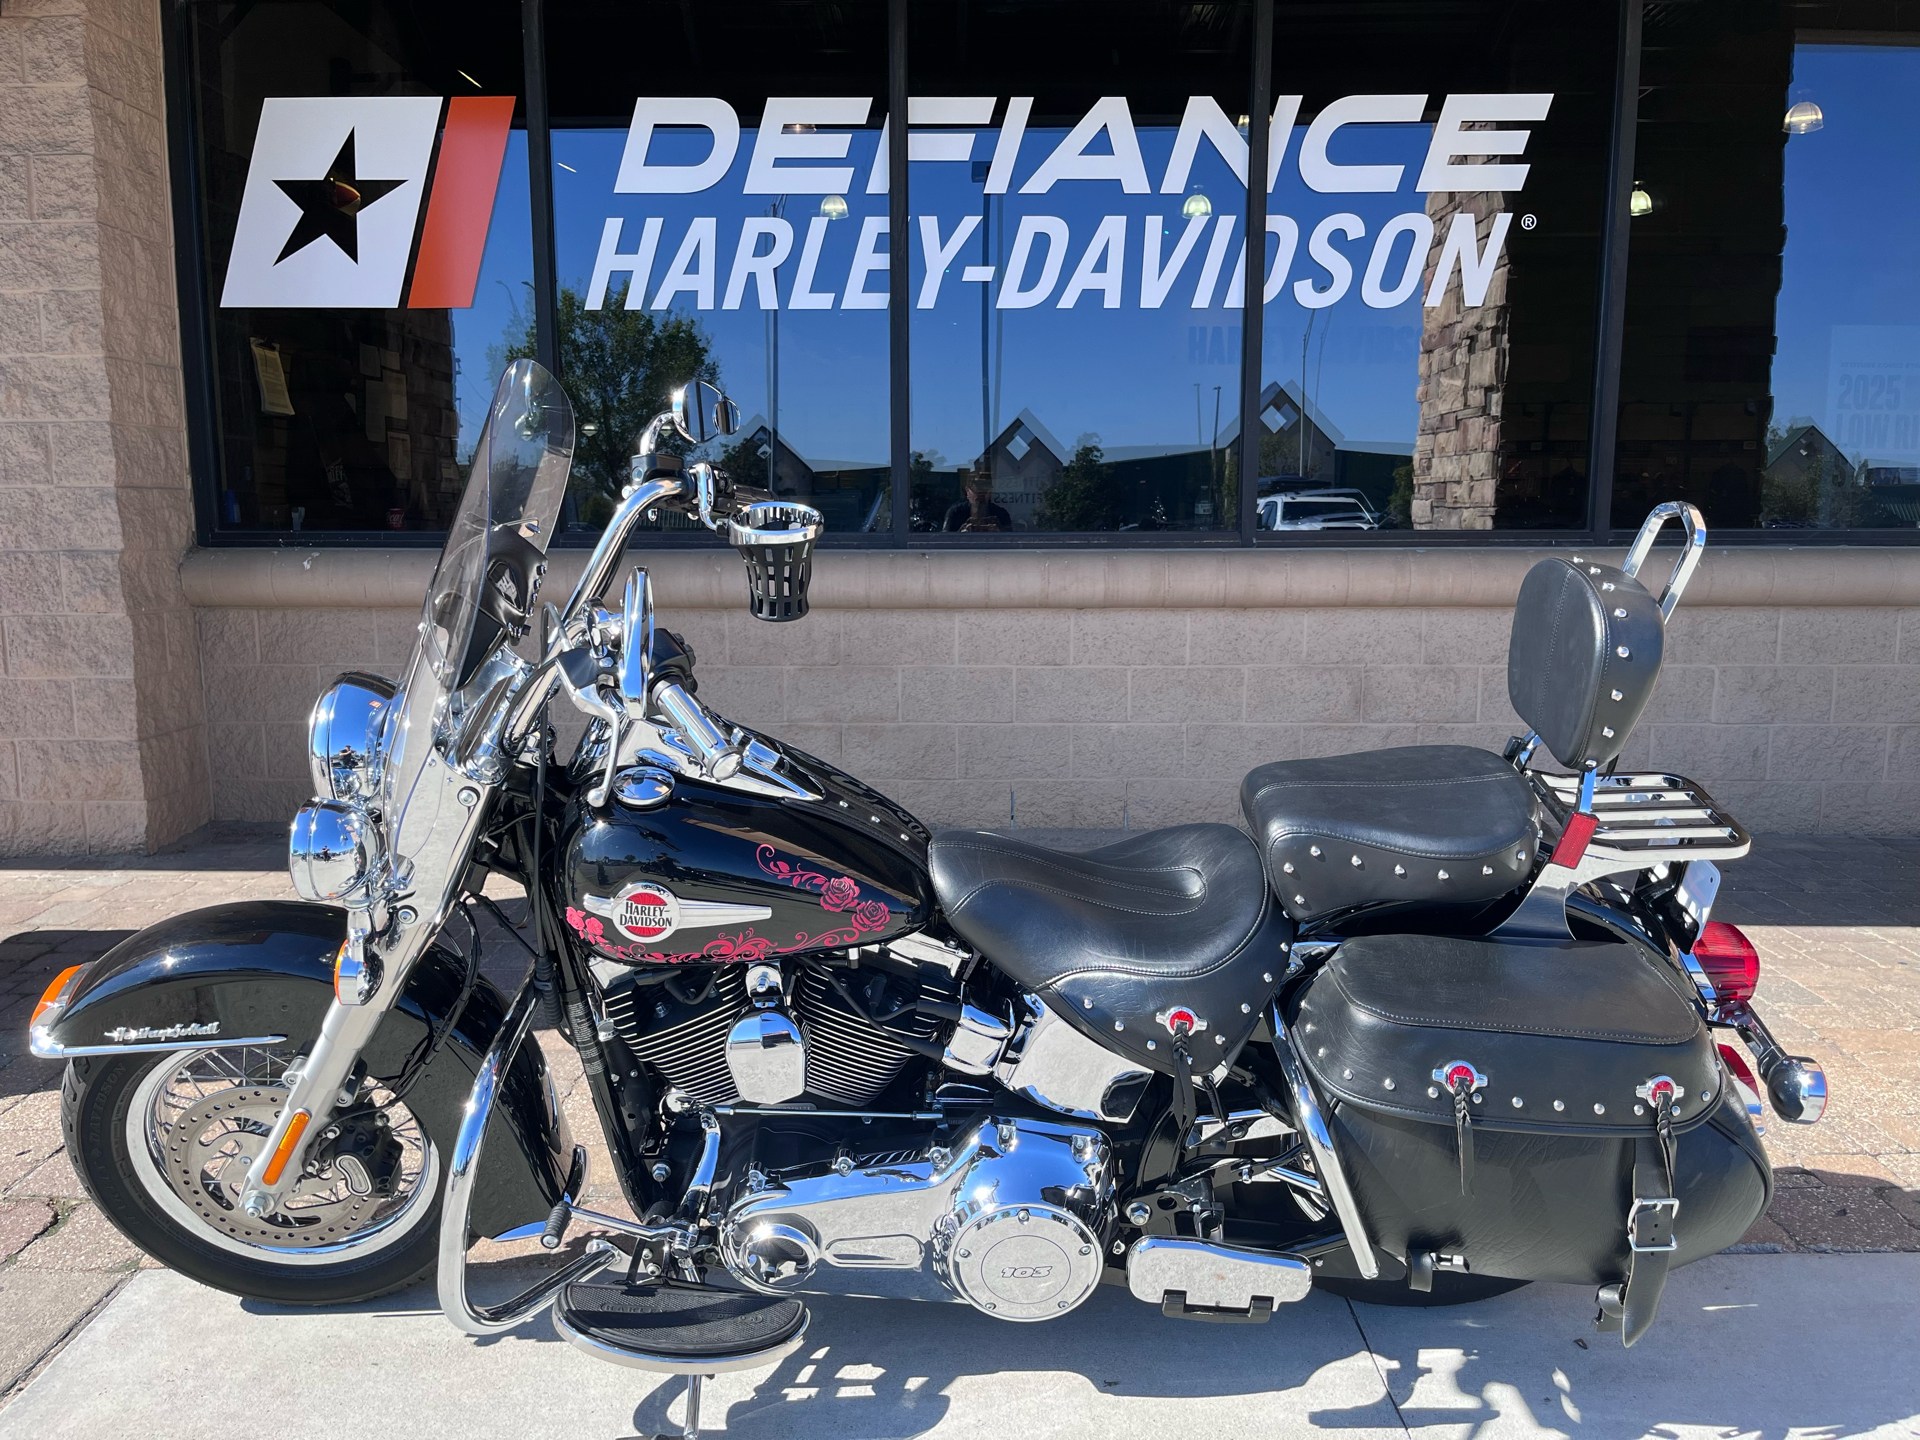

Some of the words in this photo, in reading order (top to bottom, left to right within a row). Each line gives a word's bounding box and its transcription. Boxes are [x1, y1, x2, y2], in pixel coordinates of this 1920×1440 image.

[613, 93, 1554, 196] DEFIANCE
[585, 211, 1513, 311] HARLEY-DAVIDSON
[1837, 373, 1903, 411] 2025
[1835, 413, 1891, 449] LOW
[619, 913, 673, 927] DAVIDSON
[625, 900, 671, 917] HARLEY-
[1001, 1265, 1053, 1279] 103
